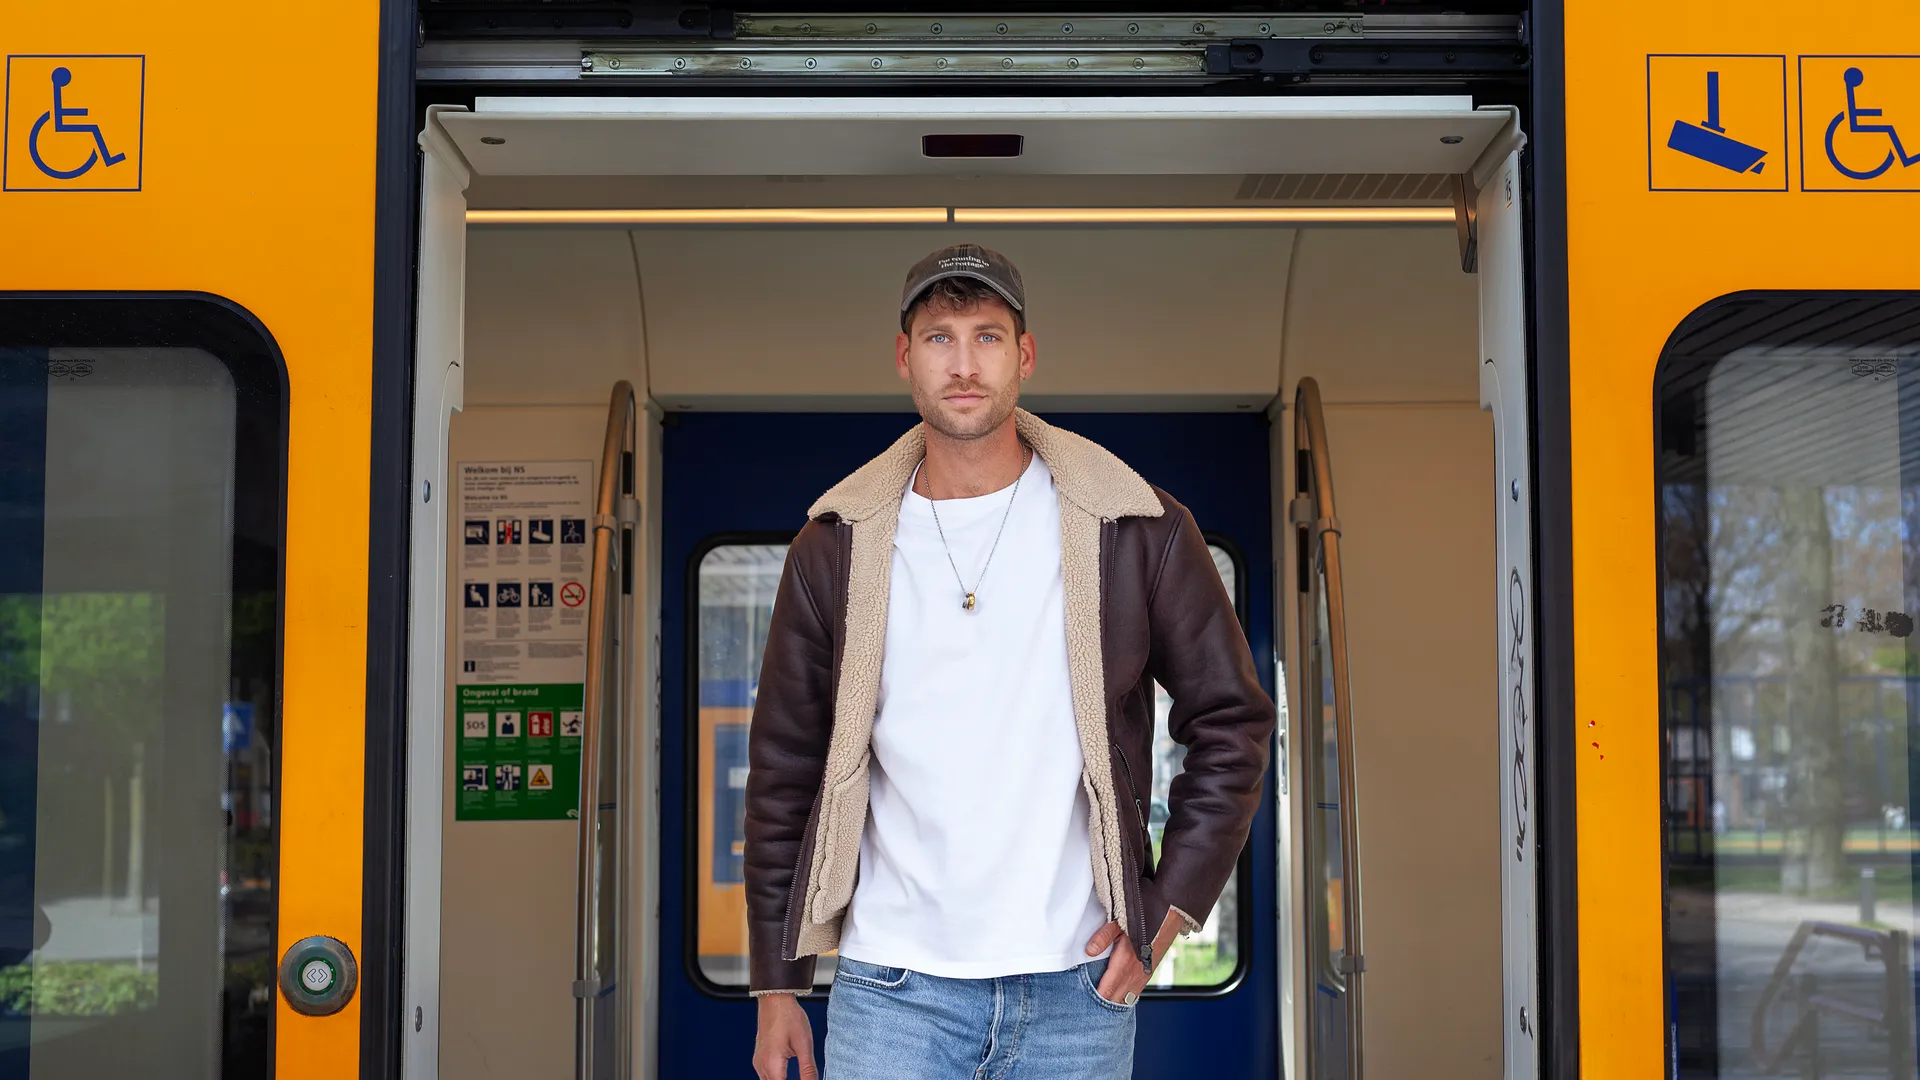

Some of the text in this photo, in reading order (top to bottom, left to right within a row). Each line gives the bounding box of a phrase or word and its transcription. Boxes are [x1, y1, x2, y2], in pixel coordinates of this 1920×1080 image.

[464, 466, 498, 474] Welkom
[500, 466, 512, 475] bij
[463, 687, 538, 698] Ongeval of brand
[466, 721, 486, 730] SOS
